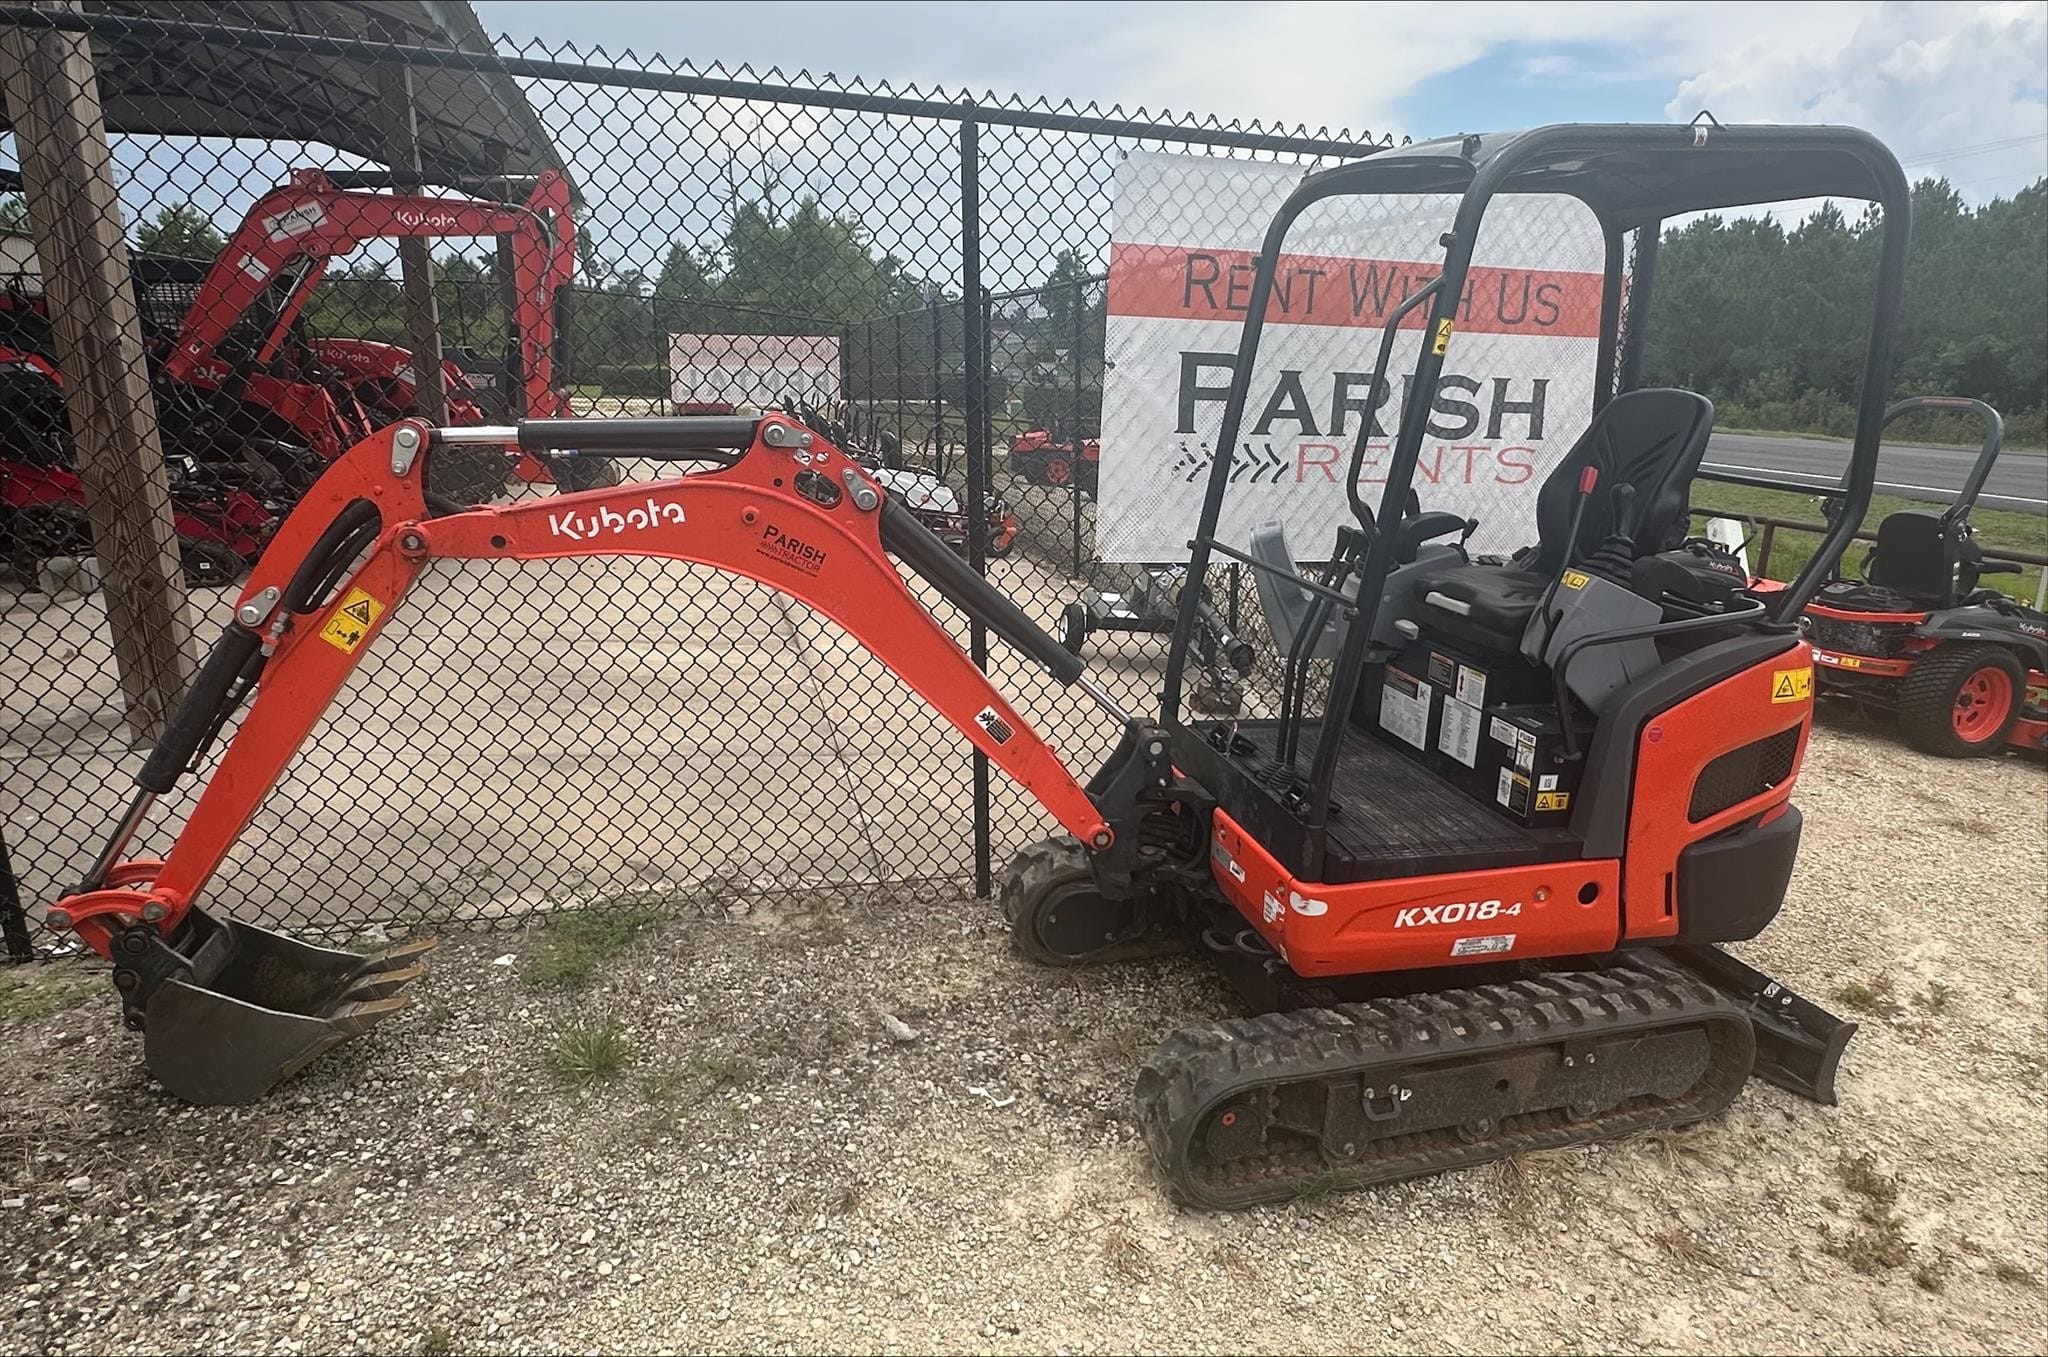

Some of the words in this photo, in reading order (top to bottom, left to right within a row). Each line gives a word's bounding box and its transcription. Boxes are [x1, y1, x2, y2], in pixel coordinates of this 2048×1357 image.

[397, 211, 457, 227] Kubota
[1182, 252, 1326, 315] RENT
[1498, 272, 1562, 327] US
[327, 349, 370, 363] Kuota
[1295, 443, 1537, 485] RENTS
[547, 497, 686, 541] Kubota
[763, 524, 827, 565] PARISH
[778, 547, 821, 573] TRACTOR
[1393, 899, 1522, 929] KX018-4
